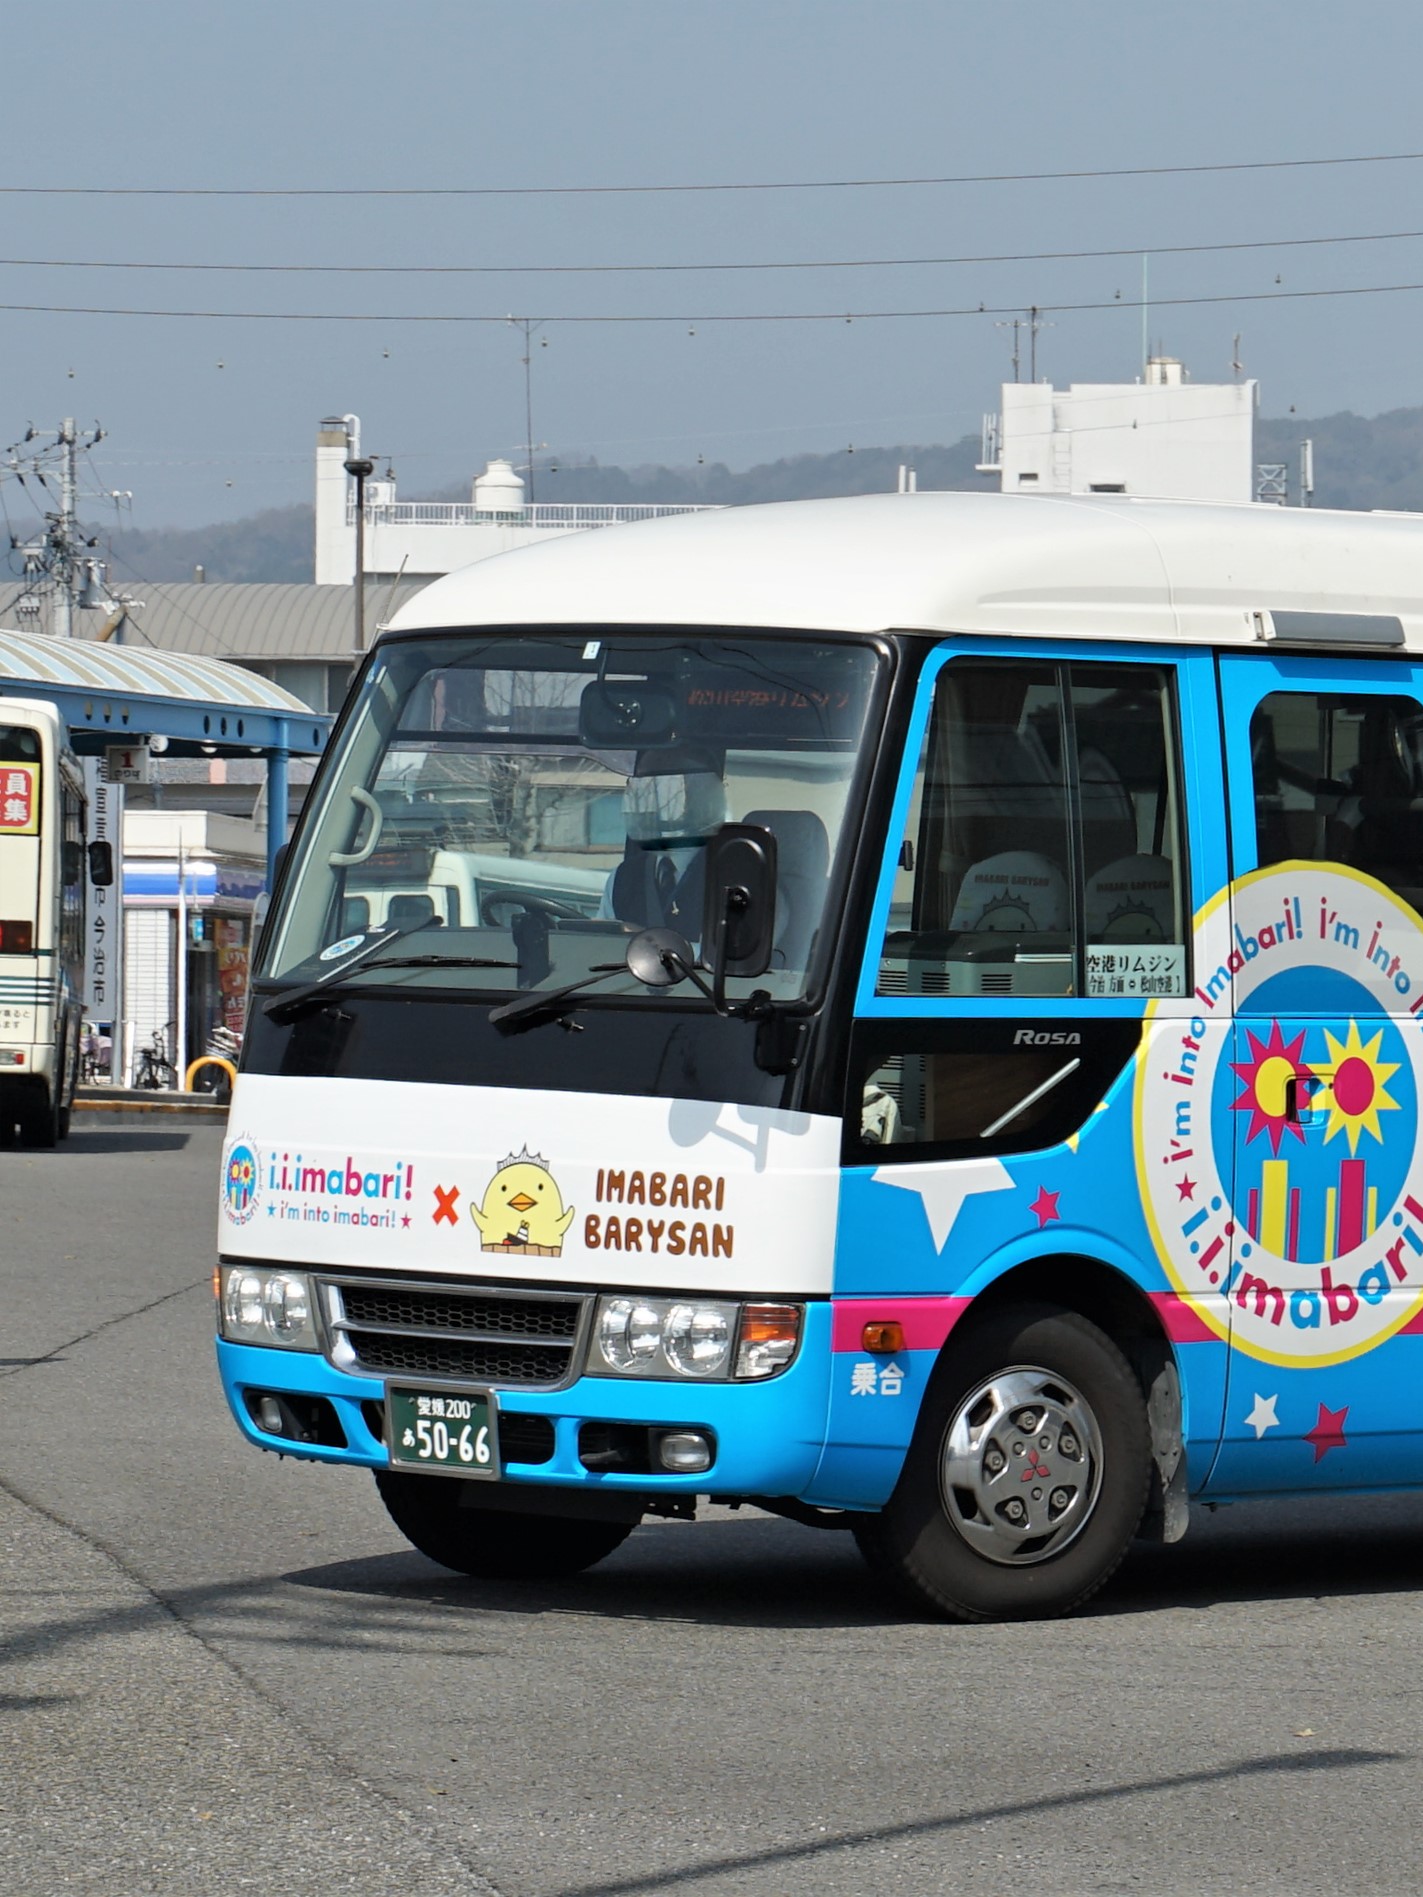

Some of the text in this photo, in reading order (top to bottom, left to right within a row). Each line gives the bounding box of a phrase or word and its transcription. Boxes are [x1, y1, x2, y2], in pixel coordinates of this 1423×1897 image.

[120, 751, 134, 768] 1
[0, 773, 28, 796] 員
[0, 798, 28, 822] 集
[1086, 954, 1177, 973] 空港リムジン
[269, 1152, 414, 1201] i.i.imabari!
[596, 1168, 725, 1212] IMABARI
[280, 1200, 396, 1229] i'm into imabari!
[584, 1213, 734, 1259] BARYSAN
[850, 1362, 905, 1397] 乗合
